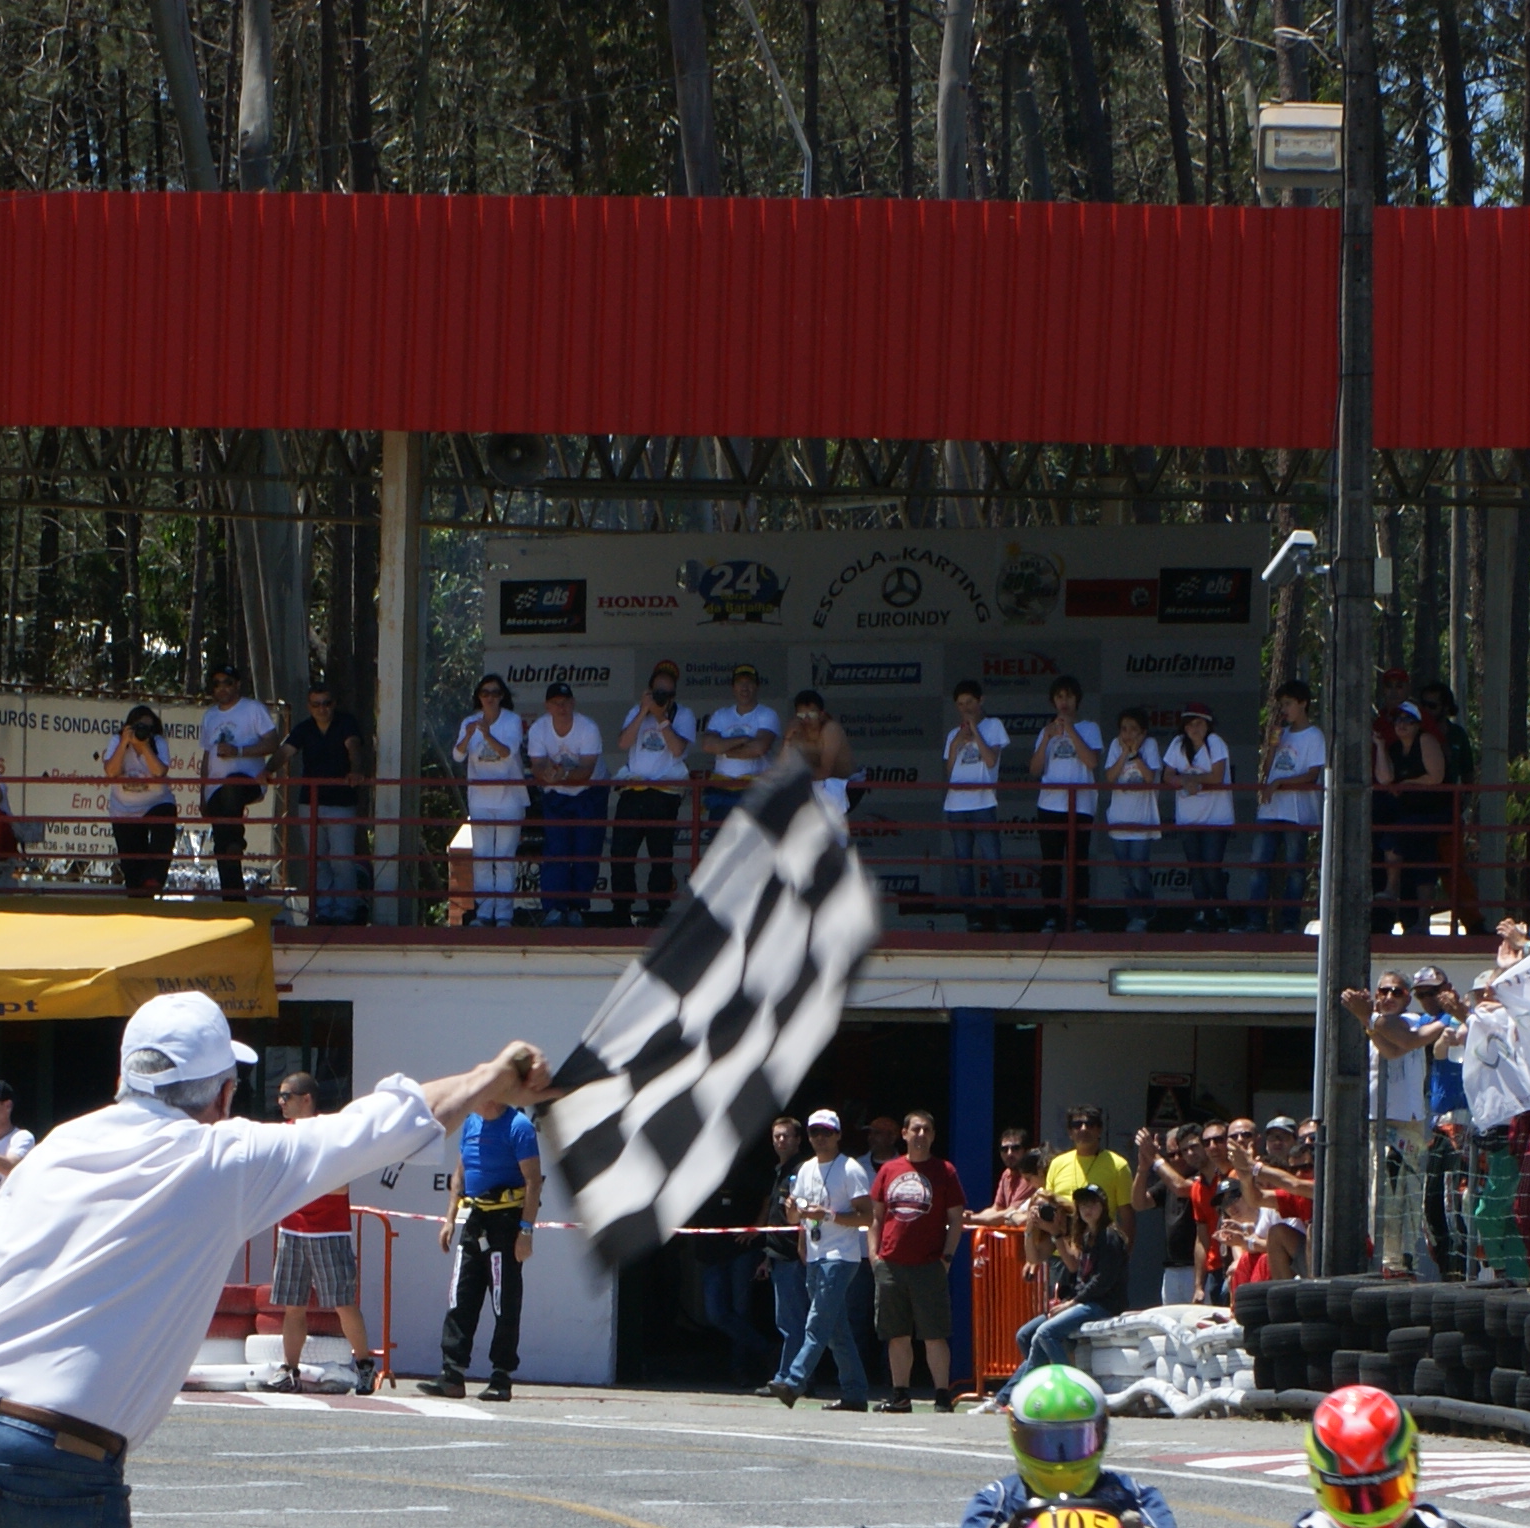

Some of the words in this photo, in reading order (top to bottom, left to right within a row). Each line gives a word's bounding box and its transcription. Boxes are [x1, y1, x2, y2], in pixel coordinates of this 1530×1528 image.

[710, 563, 761, 597] 24
[812, 551, 887, 629] ESCOLA
[902, 547, 992, 624] KARTING
[597, 596, 680, 609] HONDA
[506, 617, 568, 626] Motorsport
[857, 610, 951, 628] EUROINDY
[832, 666, 919, 679] MICHELIN
[983, 659, 1058, 675] HELIX
[41, 714, 50, 734] E
[72, 793, 91, 809] Em
[47, 821, 70, 835] Vale
[74, 822, 87, 836] da
